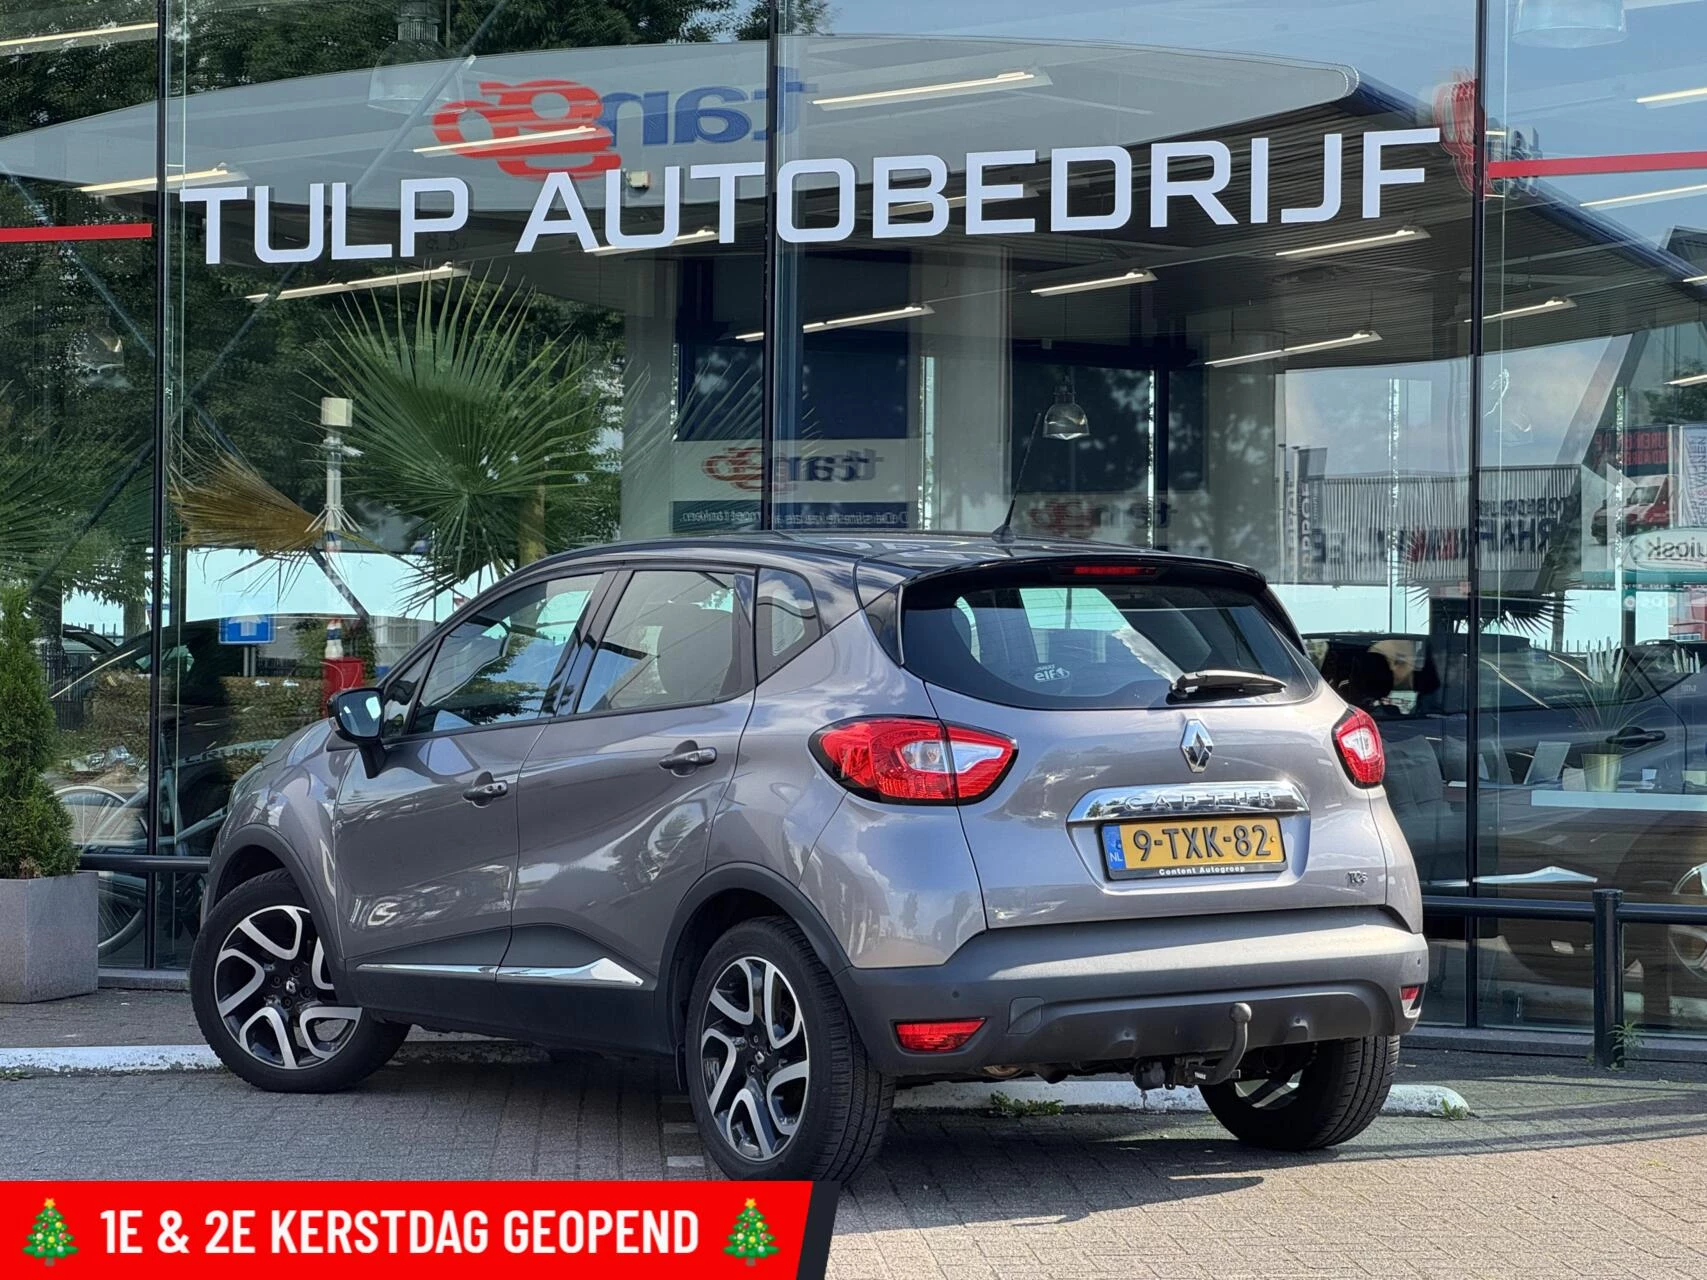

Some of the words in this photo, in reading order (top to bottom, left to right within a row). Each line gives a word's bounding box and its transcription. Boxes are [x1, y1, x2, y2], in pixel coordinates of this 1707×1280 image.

[180, 177, 469, 264] TULP
[515, 127, 1440, 253] AUTOBEDRIJF
[1033, 669, 1056, 681] elf
[1124, 791, 1275, 811] CAPTUR
[1110, 852, 1123, 862] NL
[1133, 825, 1271, 861] 9-TXK-82
[1158, 867, 1196, 876] Content
[1199, 865, 1246, 874] Autogroep
